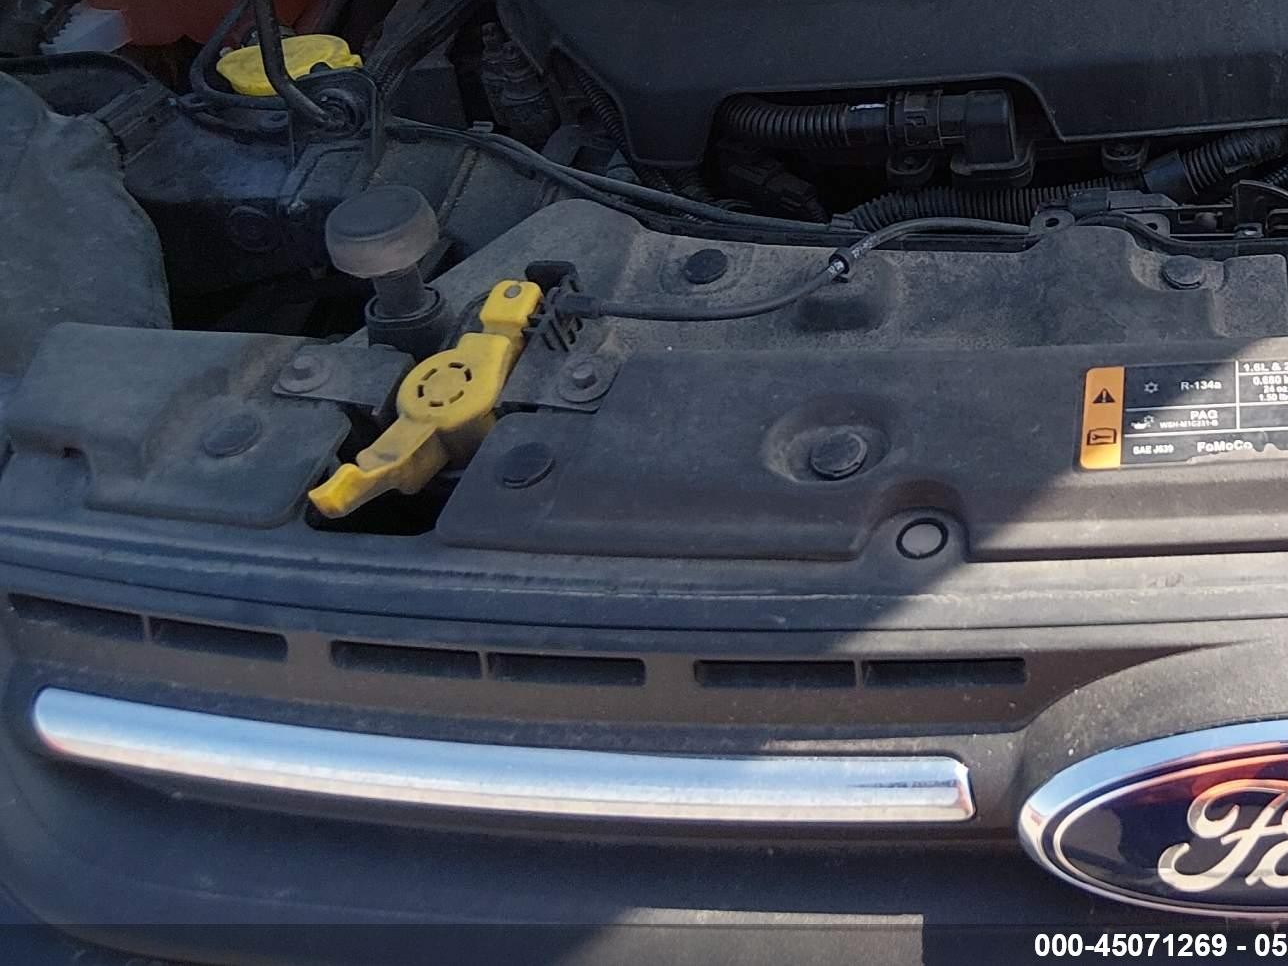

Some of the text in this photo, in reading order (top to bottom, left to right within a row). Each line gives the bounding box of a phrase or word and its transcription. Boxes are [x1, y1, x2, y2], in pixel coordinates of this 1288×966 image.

[1271, 362, 1281, 371] &
[1180, 380, 1222, 390] R-134a
[1190, 410, 1218, 420] PAG
[1196, 440, 1253, 452] FoMoCo
